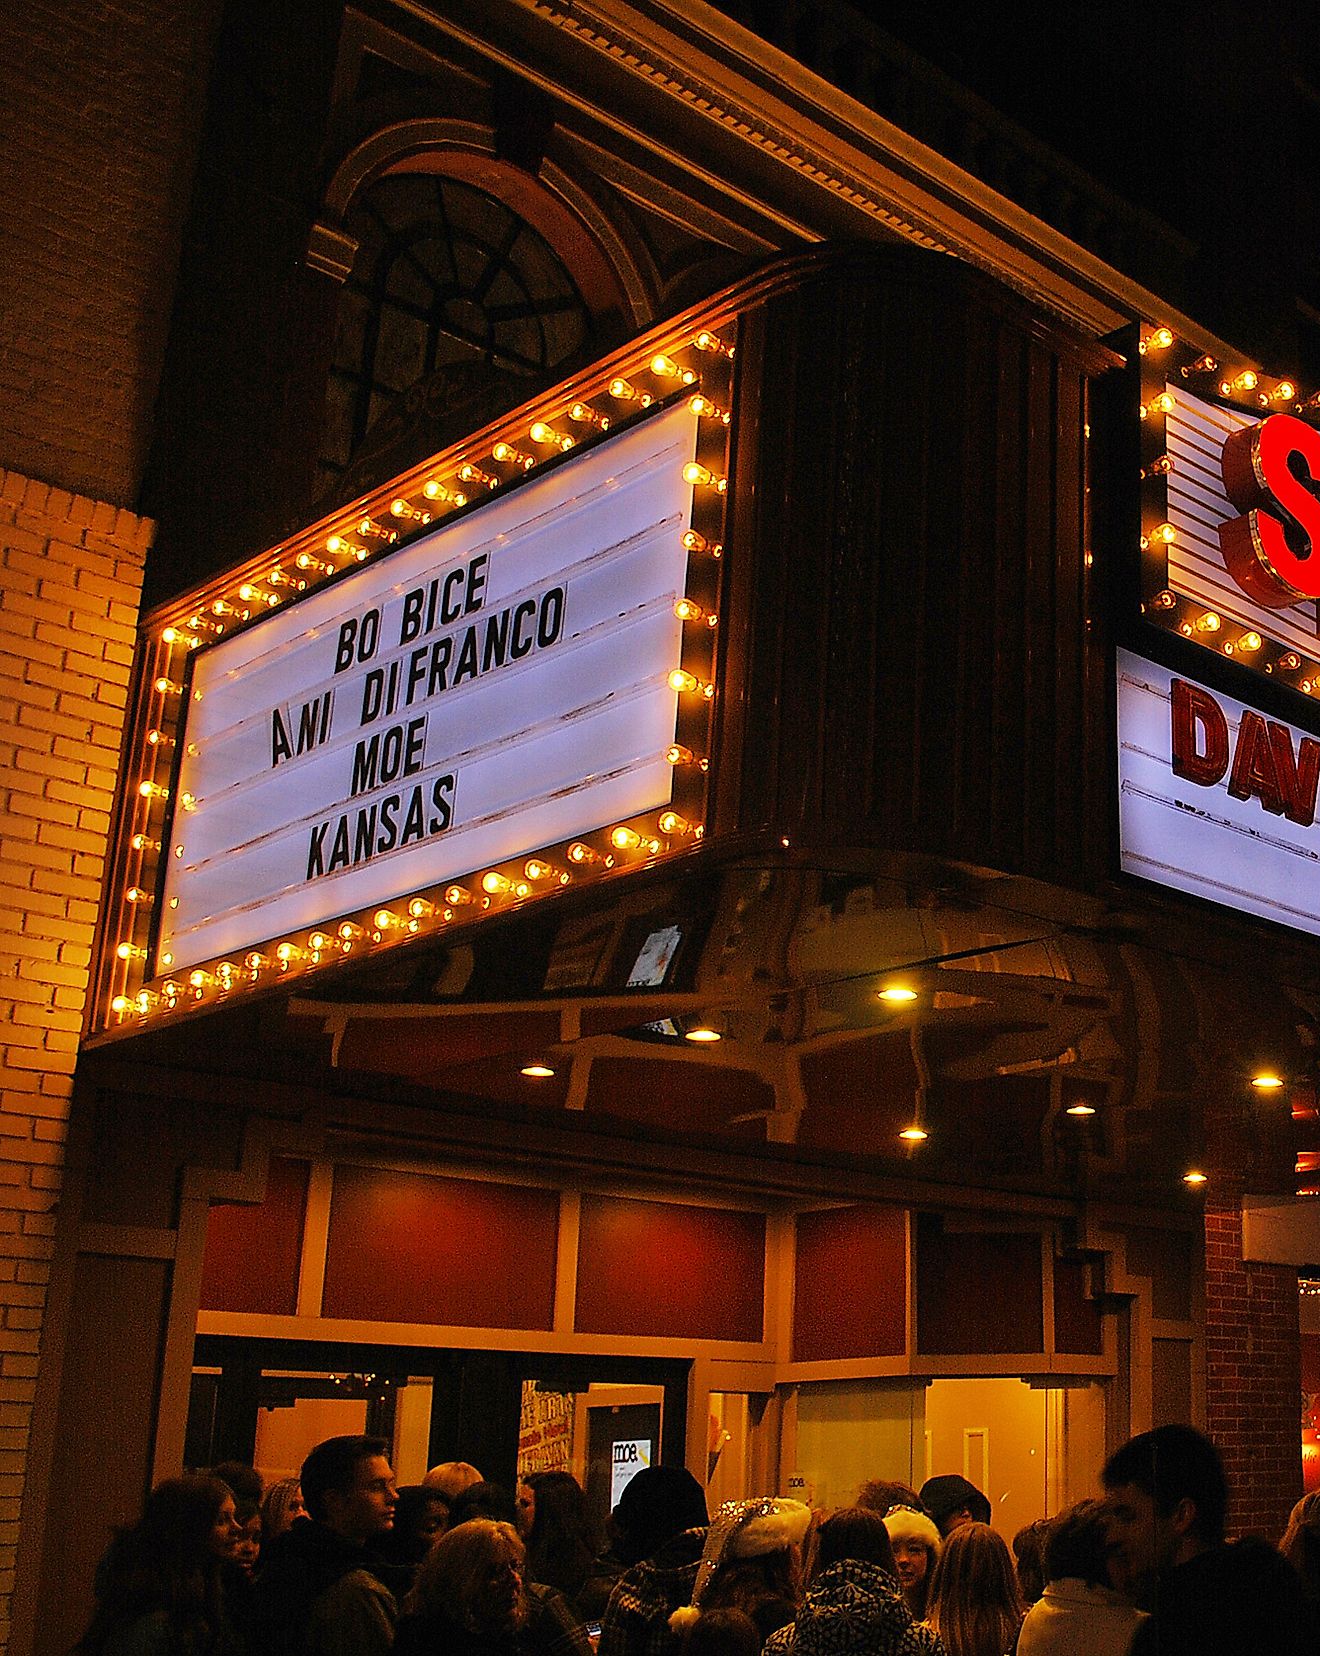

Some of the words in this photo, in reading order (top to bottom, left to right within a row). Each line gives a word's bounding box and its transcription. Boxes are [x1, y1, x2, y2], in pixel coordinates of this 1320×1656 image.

[333, 608, 381, 675] BO
[398, 553, 489, 647] BICE
[271, 690, 333, 769] ANI
[344, 715, 427, 804] MOE
[306, 774, 455, 881] KANSAS
